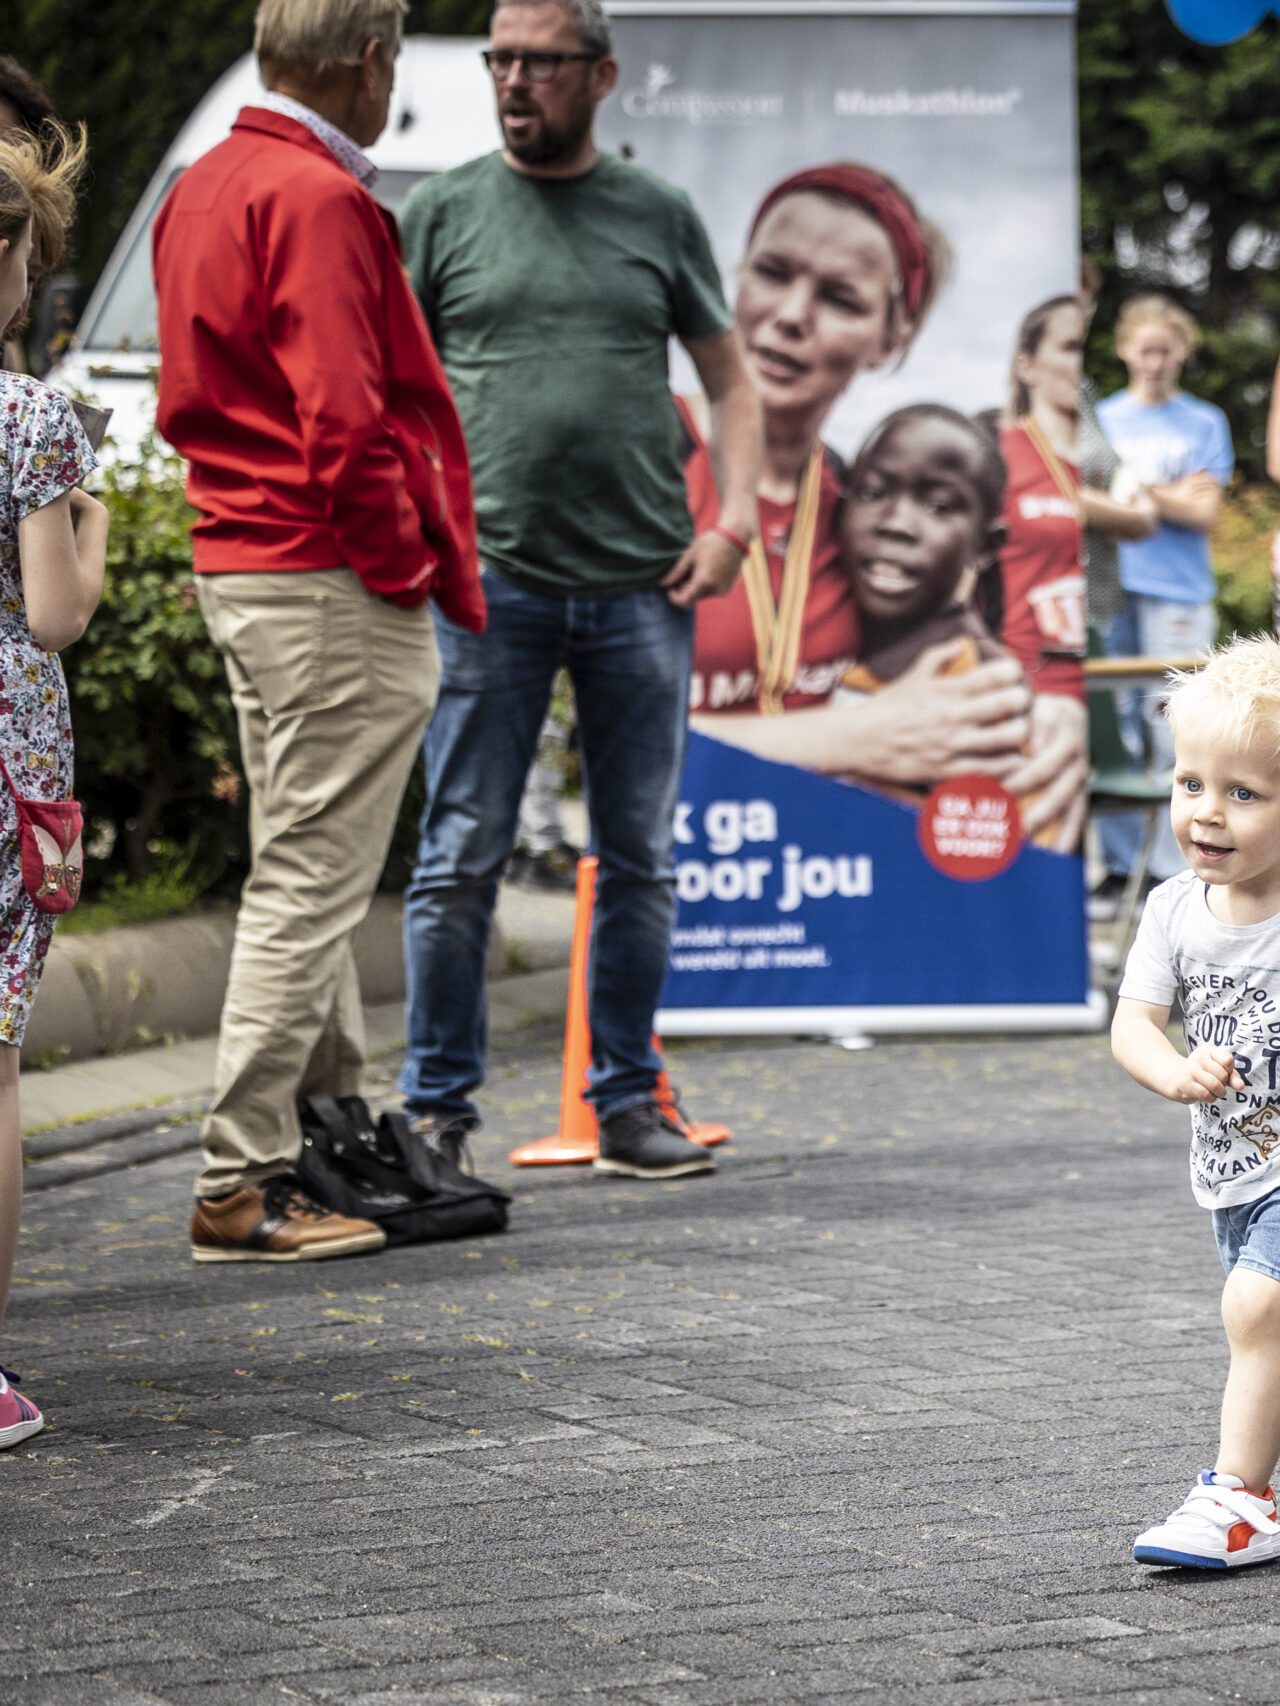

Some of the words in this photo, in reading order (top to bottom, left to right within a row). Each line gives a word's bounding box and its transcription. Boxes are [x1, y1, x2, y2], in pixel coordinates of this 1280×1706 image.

[673, 801, 696, 845] k
[703, 800, 779, 856] ga
[675, 856, 774, 903] oor
[776, 843, 874, 913] jou
[1242, 981, 1278, 1014] YOU
[1247, 1005, 1265, 1044] WITH
